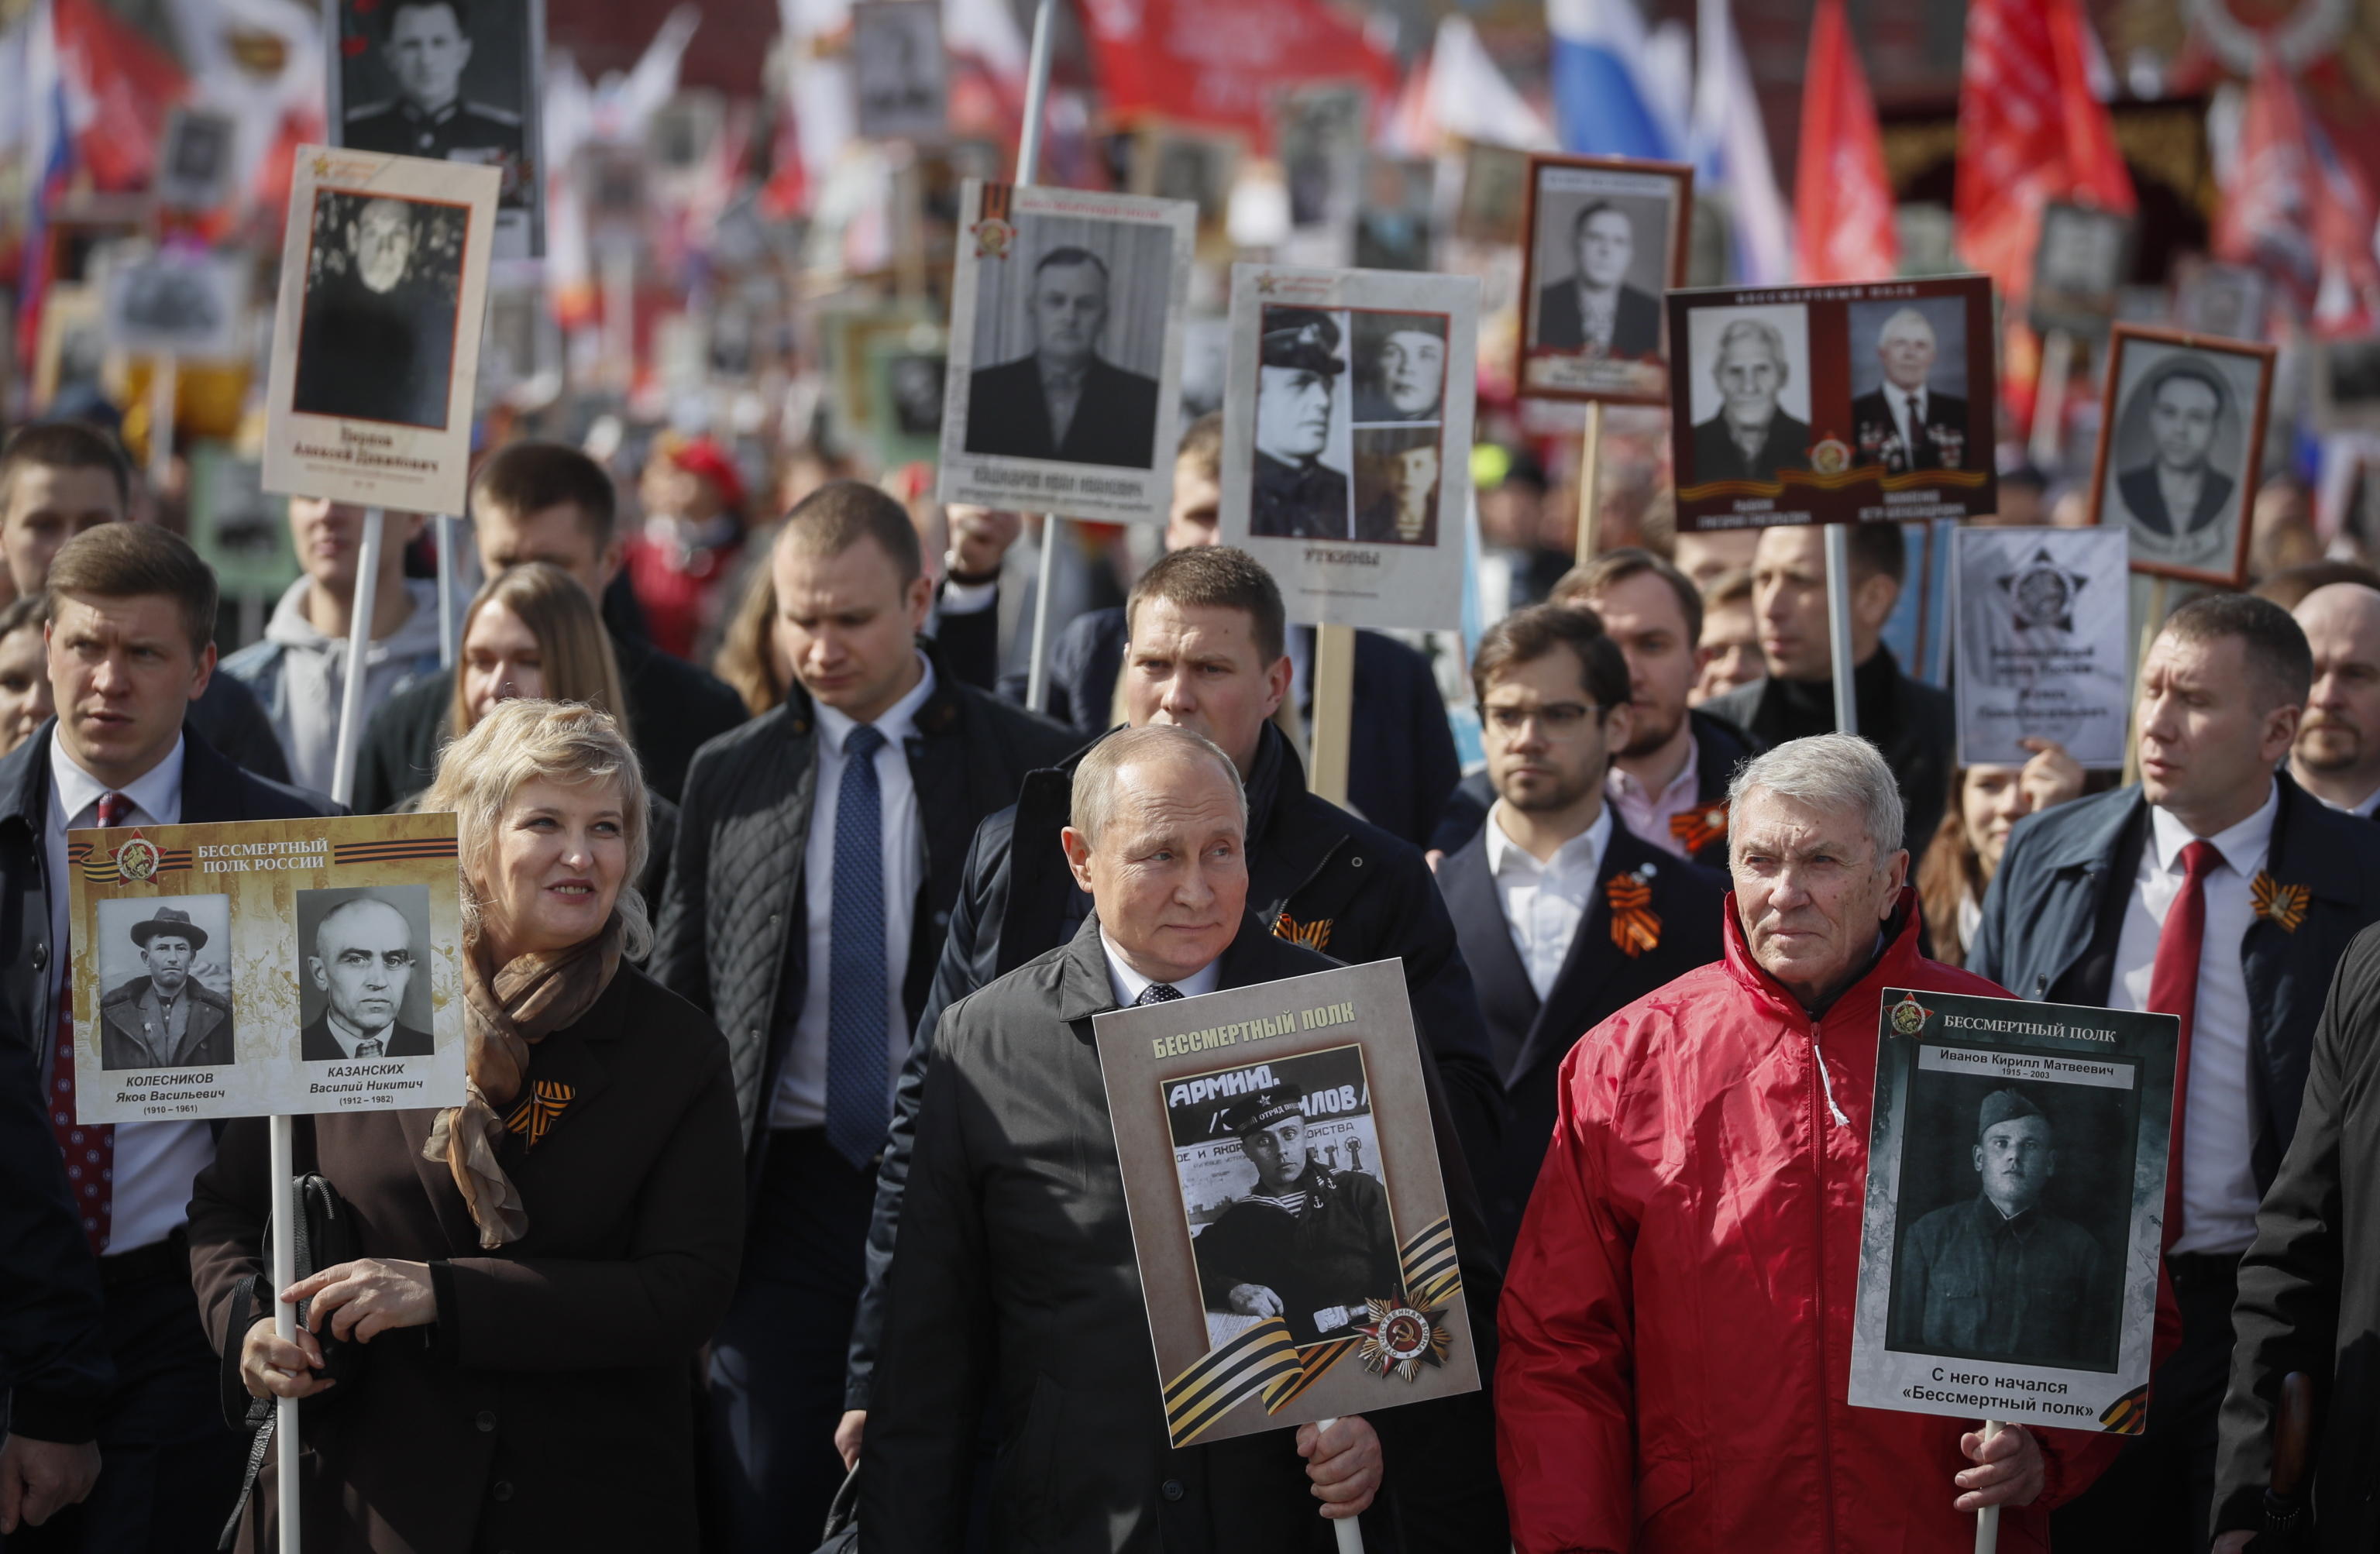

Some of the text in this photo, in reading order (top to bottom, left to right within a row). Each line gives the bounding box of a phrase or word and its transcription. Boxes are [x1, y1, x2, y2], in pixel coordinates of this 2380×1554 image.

[198, 837, 328, 858] БЕССМЕРТНЫЙ
[204, 856, 325, 873] ПОЛК РОССИИ
[1152, 1002, 1356, 1059] БЕССМЕРТНЫЙ ПОЛК
[1944, 1015, 2117, 1043] БЕССМЕРТНЫЙ ПОЛК
[1940, 1049, 2114, 1075] Иванов Кирилл Матвеевич
[328, 1064, 404, 1078] КАЗАНСКИХ
[2002, 1068, 2021, 1076] 1915
[2031, 1071, 2050, 1079] 2003
[126, 1073, 214, 1087] КОЛЕСНИКОВ
[310, 1081, 423, 1093] Василий Никитич
[115, 1090, 225, 1102] Яков Васильевич
[339, 1096, 362, 1106] (1912
[372, 1095, 394, 1105] 1982)
[143, 1105, 166, 1116] (1910
[176, 1105, 198, 1113] 1961)
[1259, 1105, 1285, 1120] ОТРЯД
[1198, 1150, 1206, 1159] И
[1931, 1367, 2068, 1394] С него начался
[1903, 1385, 2094, 1417] «Бессмертный полк»
